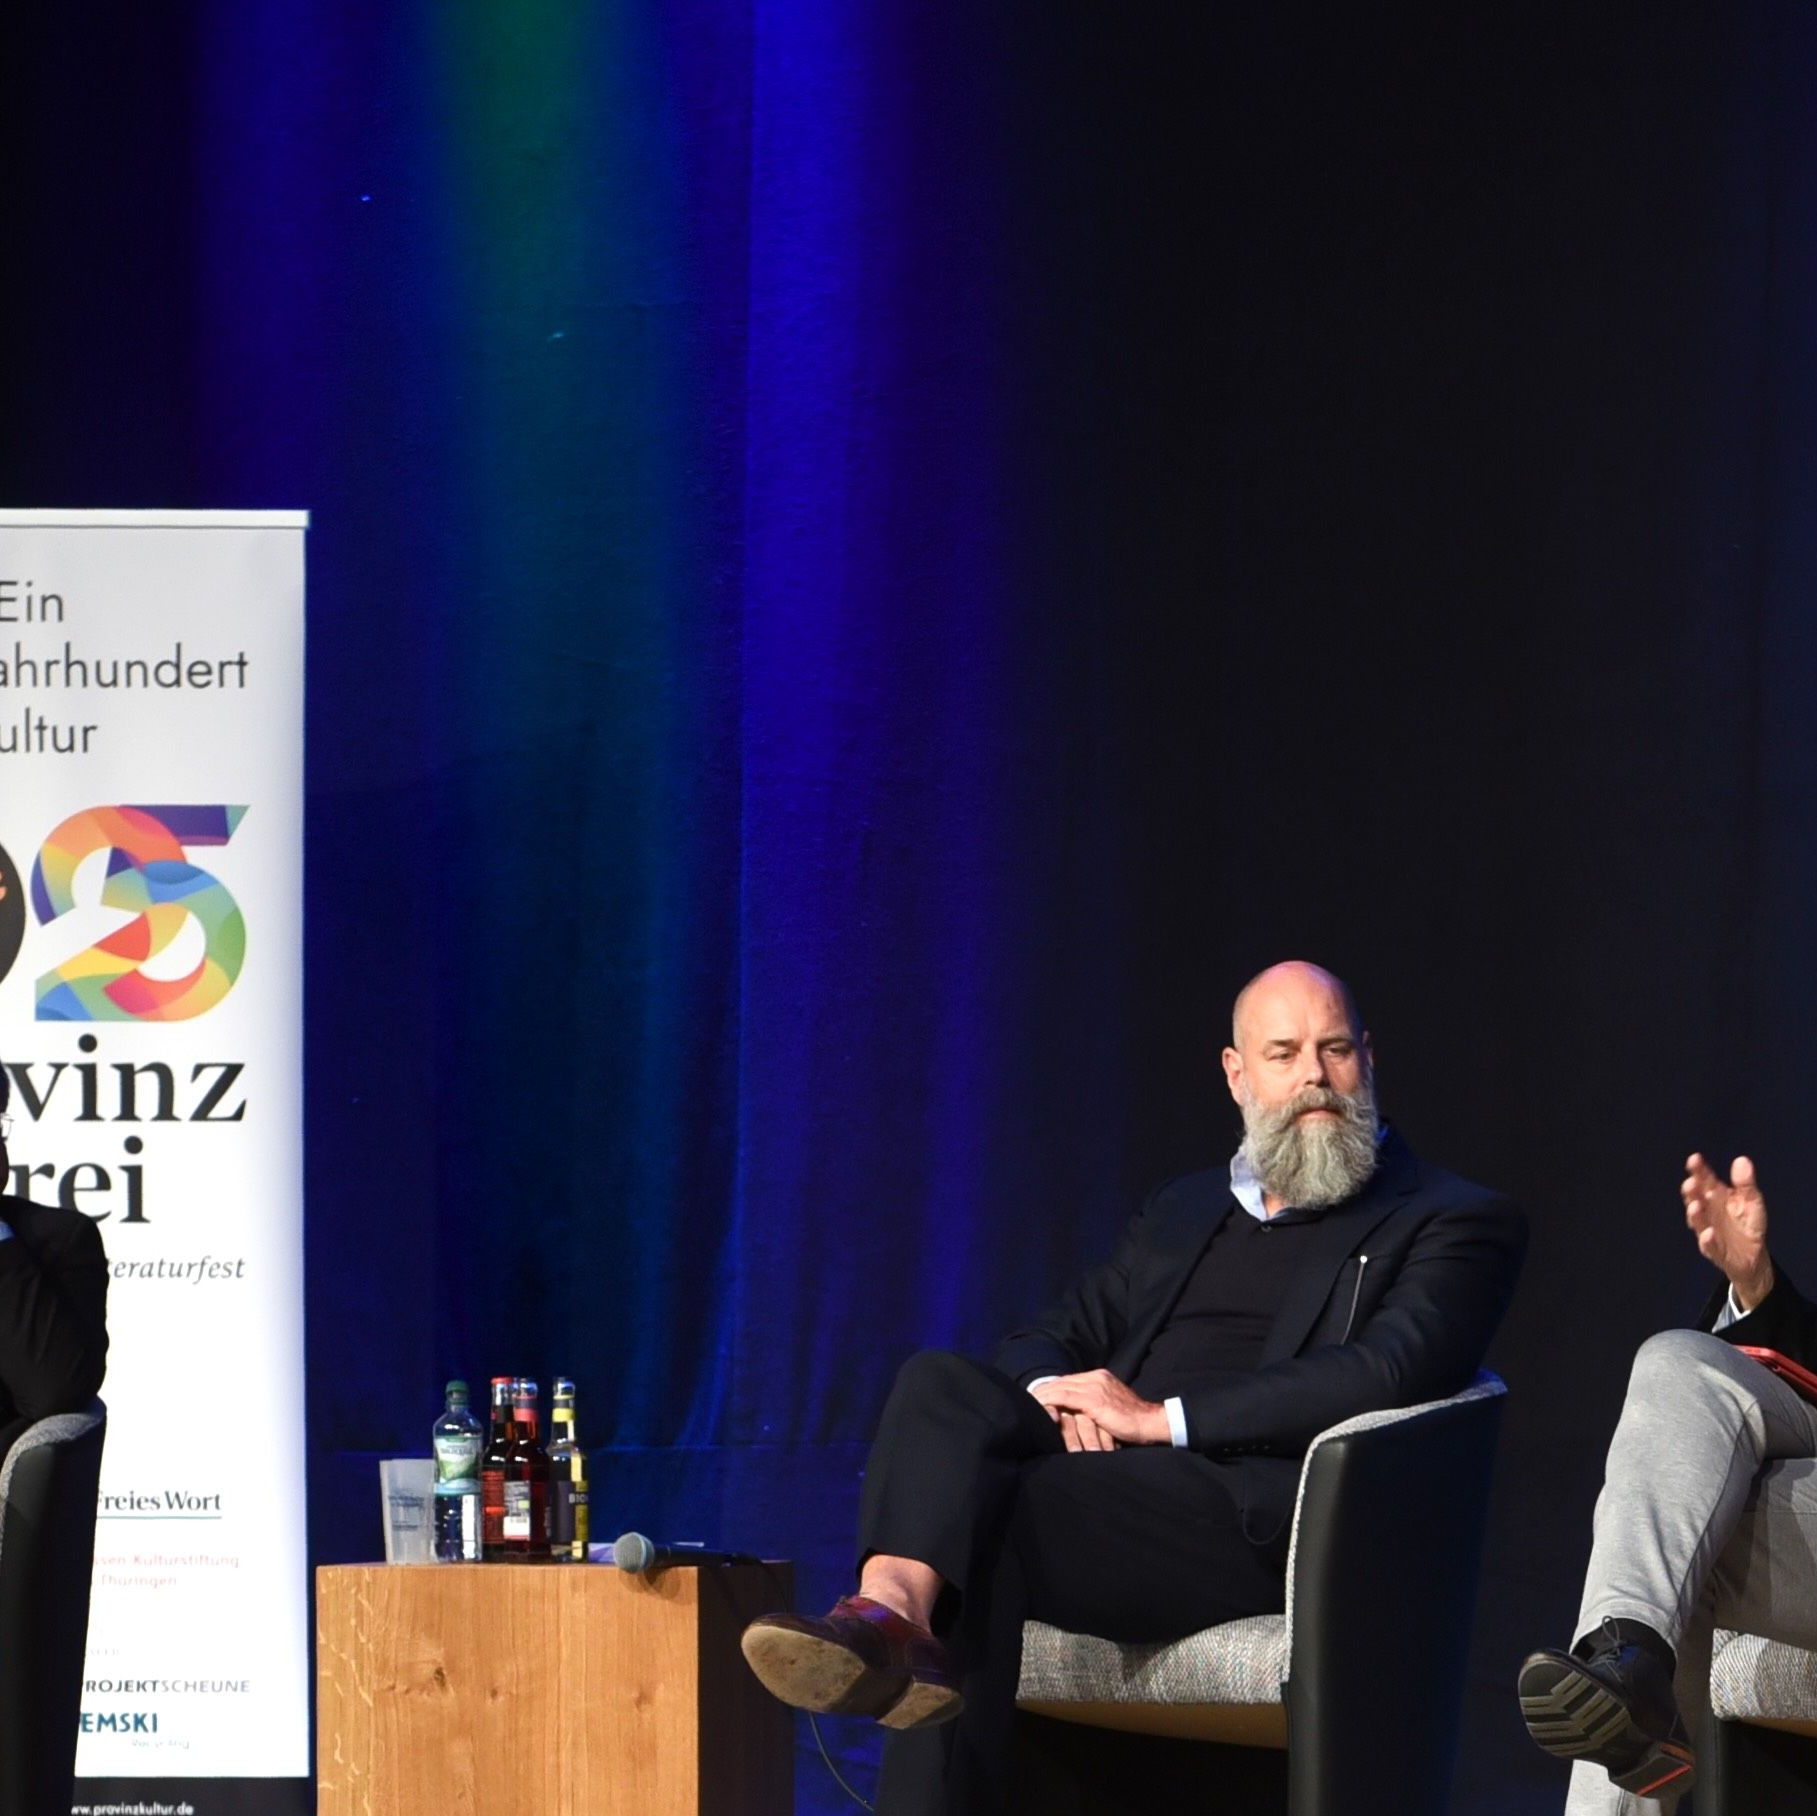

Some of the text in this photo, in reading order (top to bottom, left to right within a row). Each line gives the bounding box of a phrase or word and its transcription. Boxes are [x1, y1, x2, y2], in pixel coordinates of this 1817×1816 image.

[99, 1490, 221, 1511] reies Wort
[83, 1679, 250, 1693] ROJEKTSCHEUNE
[81, 1713, 158, 1733] EMSKI
